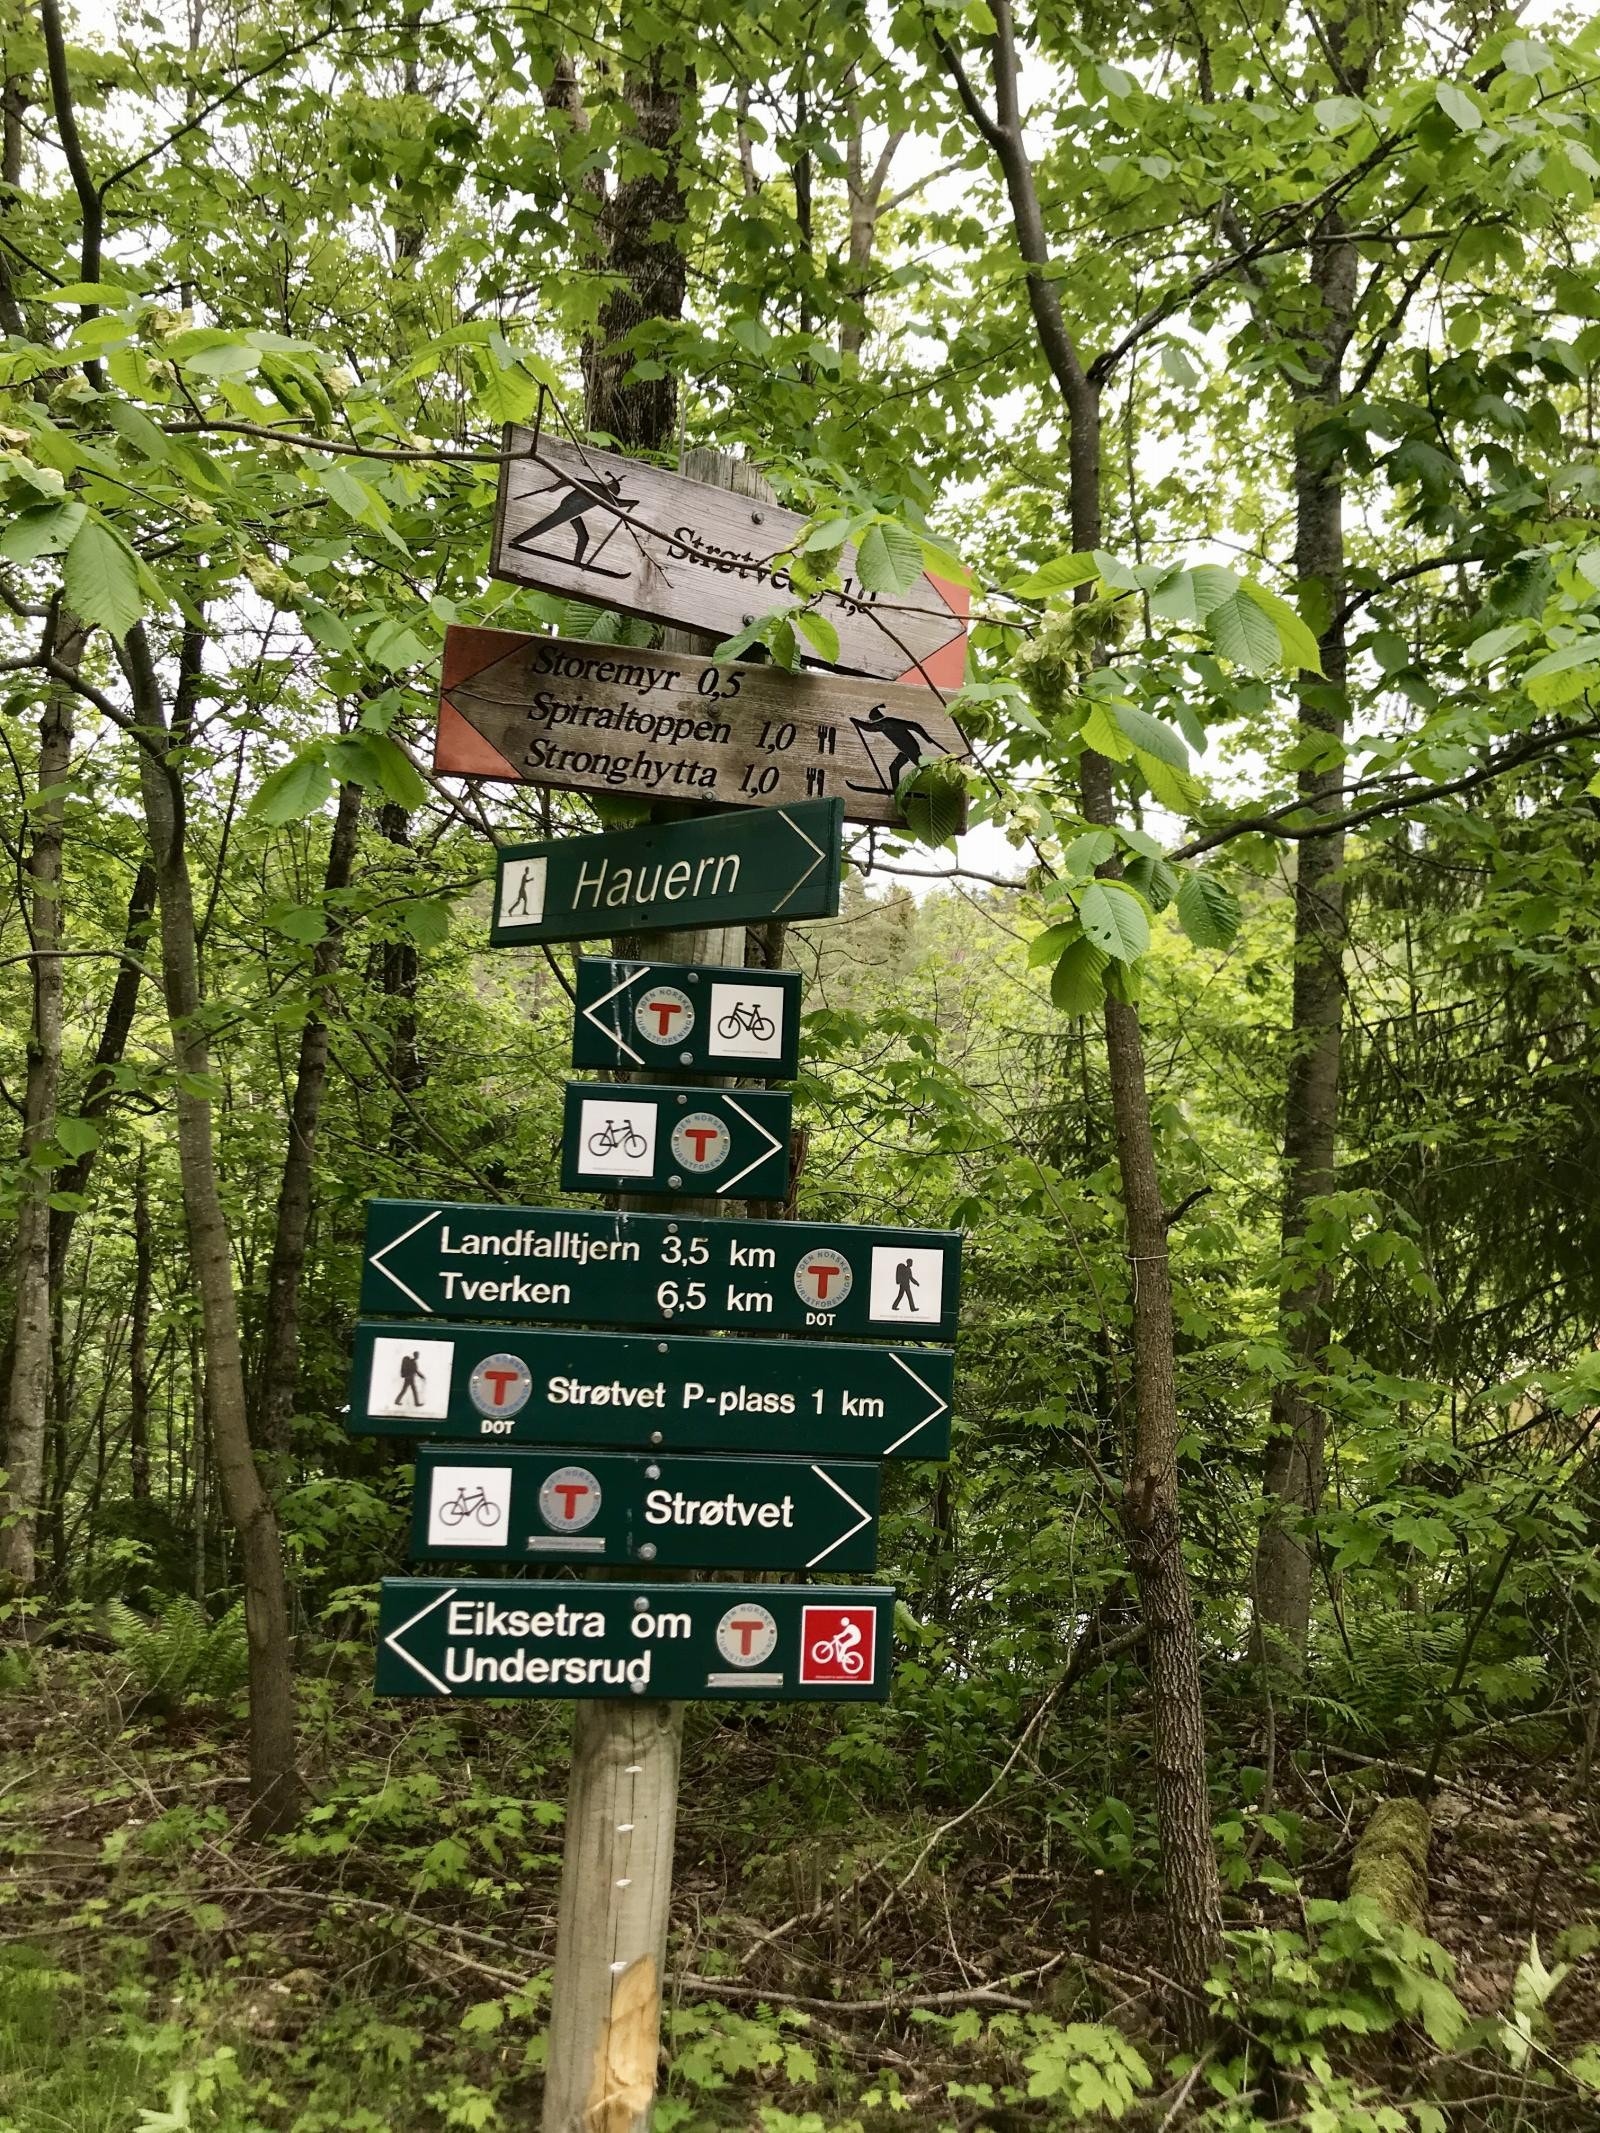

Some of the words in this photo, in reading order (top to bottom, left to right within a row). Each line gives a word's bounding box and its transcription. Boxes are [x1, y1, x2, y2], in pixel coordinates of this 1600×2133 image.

[667, 527, 823, 600] Strøtve
[532, 645, 680, 695] Storemyr
[697, 667, 746, 701] 0,5
[528, 691, 732, 745] Spiraltoppen
[755, 720, 797, 754] 1,0
[524, 738, 717, 787] Stronghytta
[738, 763, 780, 798] 1,0
[572, 854, 740, 910] Hauern
[441, 1226, 640, 1265] Landfalltjern
[661, 1236, 709, 1267] 3,5
[730, 1239, 776, 1268] km
[818, 1250, 848, 1274] NORSKE
[439, 1272, 571, 1304] Tverken
[657, 1280, 706, 1312] 6,5
[727, 1284, 773, 1313] km
[806, 1312, 836, 1326] DOT
[547, 1376, 666, 1408] Strøtvet
[683, 1382, 796, 1416] P-plass
[812, 1389, 824, 1415] 1
[842, 1390, 885, 1418] km
[481, 1420, 515, 1434] DOT
[645, 1489, 794, 1528] Strøtvet
[448, 1601, 606, 1638] Eiksetra
[631, 1612, 692, 1638] om
[445, 1647, 652, 1684] Undersrud
